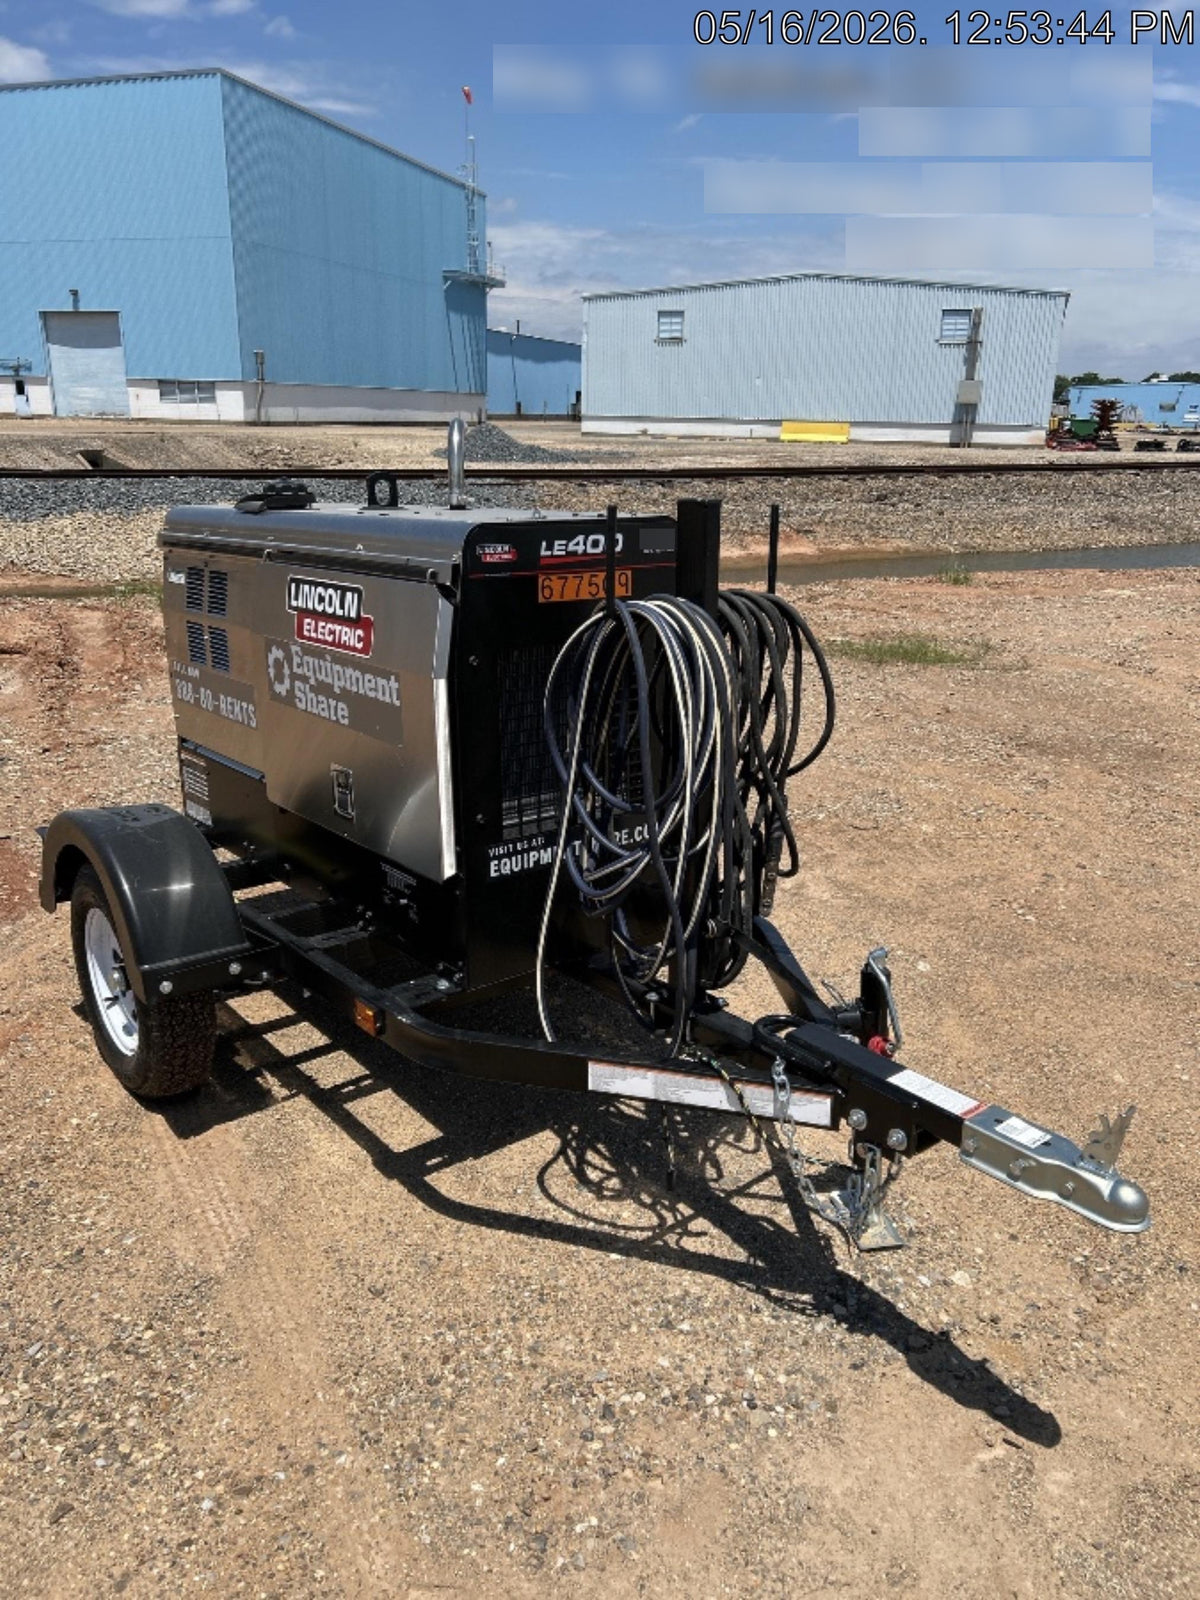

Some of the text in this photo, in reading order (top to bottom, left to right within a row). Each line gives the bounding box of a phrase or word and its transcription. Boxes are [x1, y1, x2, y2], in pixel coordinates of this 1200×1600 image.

[290, 582, 358, 619] LINCOLN
[303, 618, 365, 650] ELECTRIC
[290, 645, 400, 706] Equipment
[294, 681, 349, 725] Share
[488, 843, 513, 857] VISIT
[516, 840, 527, 851] US
